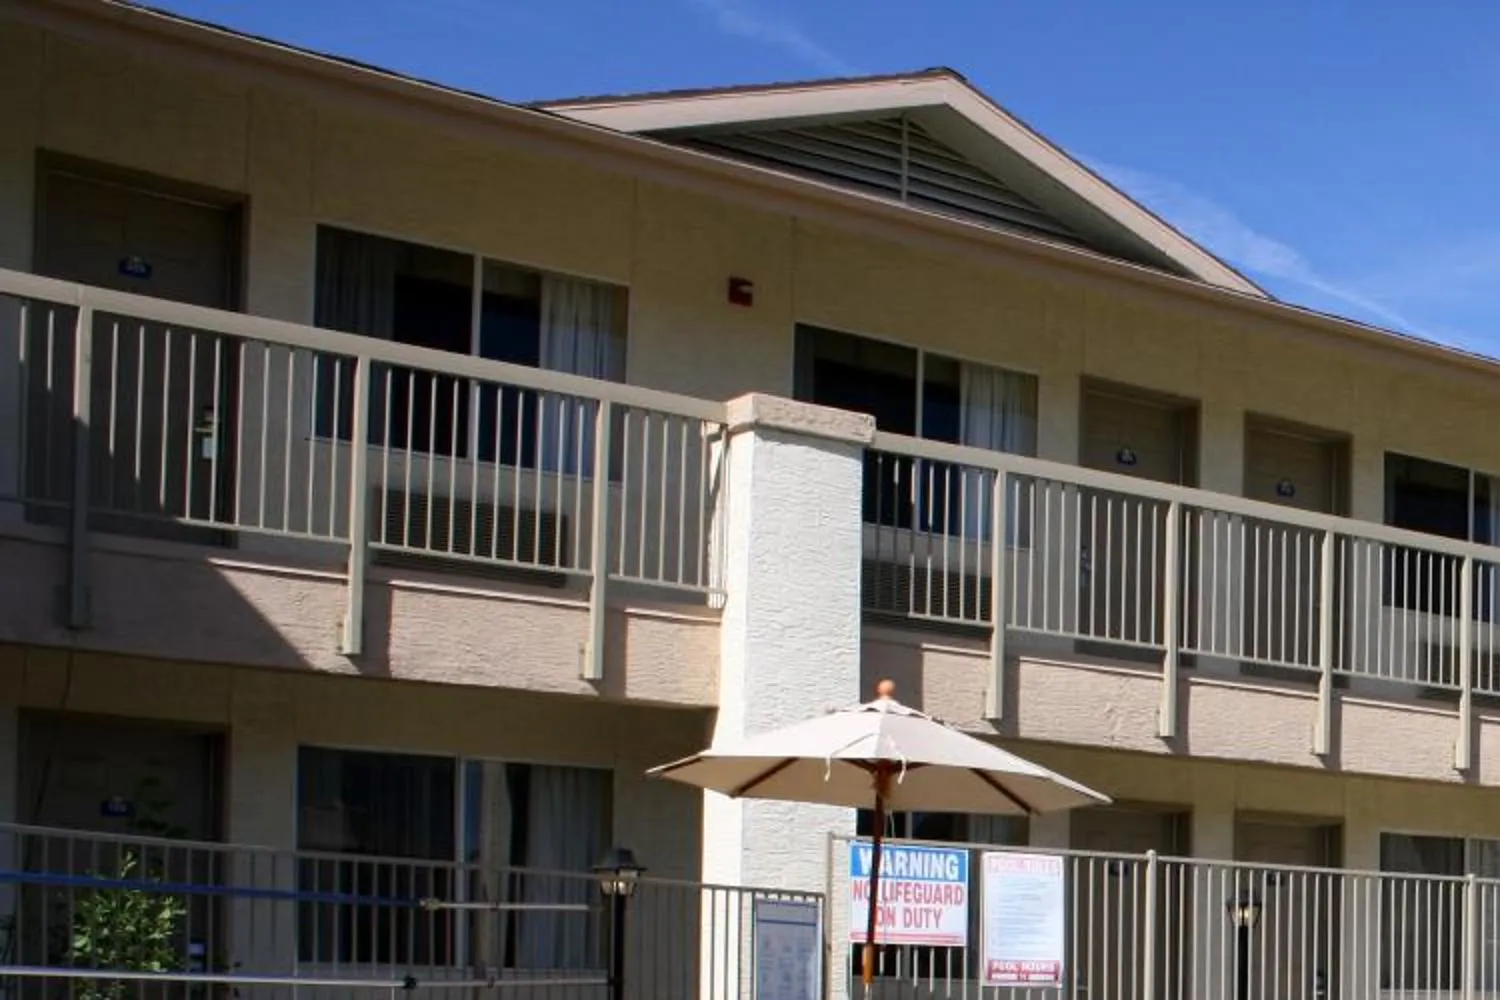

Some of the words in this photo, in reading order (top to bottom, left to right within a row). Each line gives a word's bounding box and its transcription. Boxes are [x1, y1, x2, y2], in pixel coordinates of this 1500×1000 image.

[859, 847, 960, 880] WARNING
[881, 881, 965, 906] LIFEGUARD
[903, 907, 943, 928] DUTY
